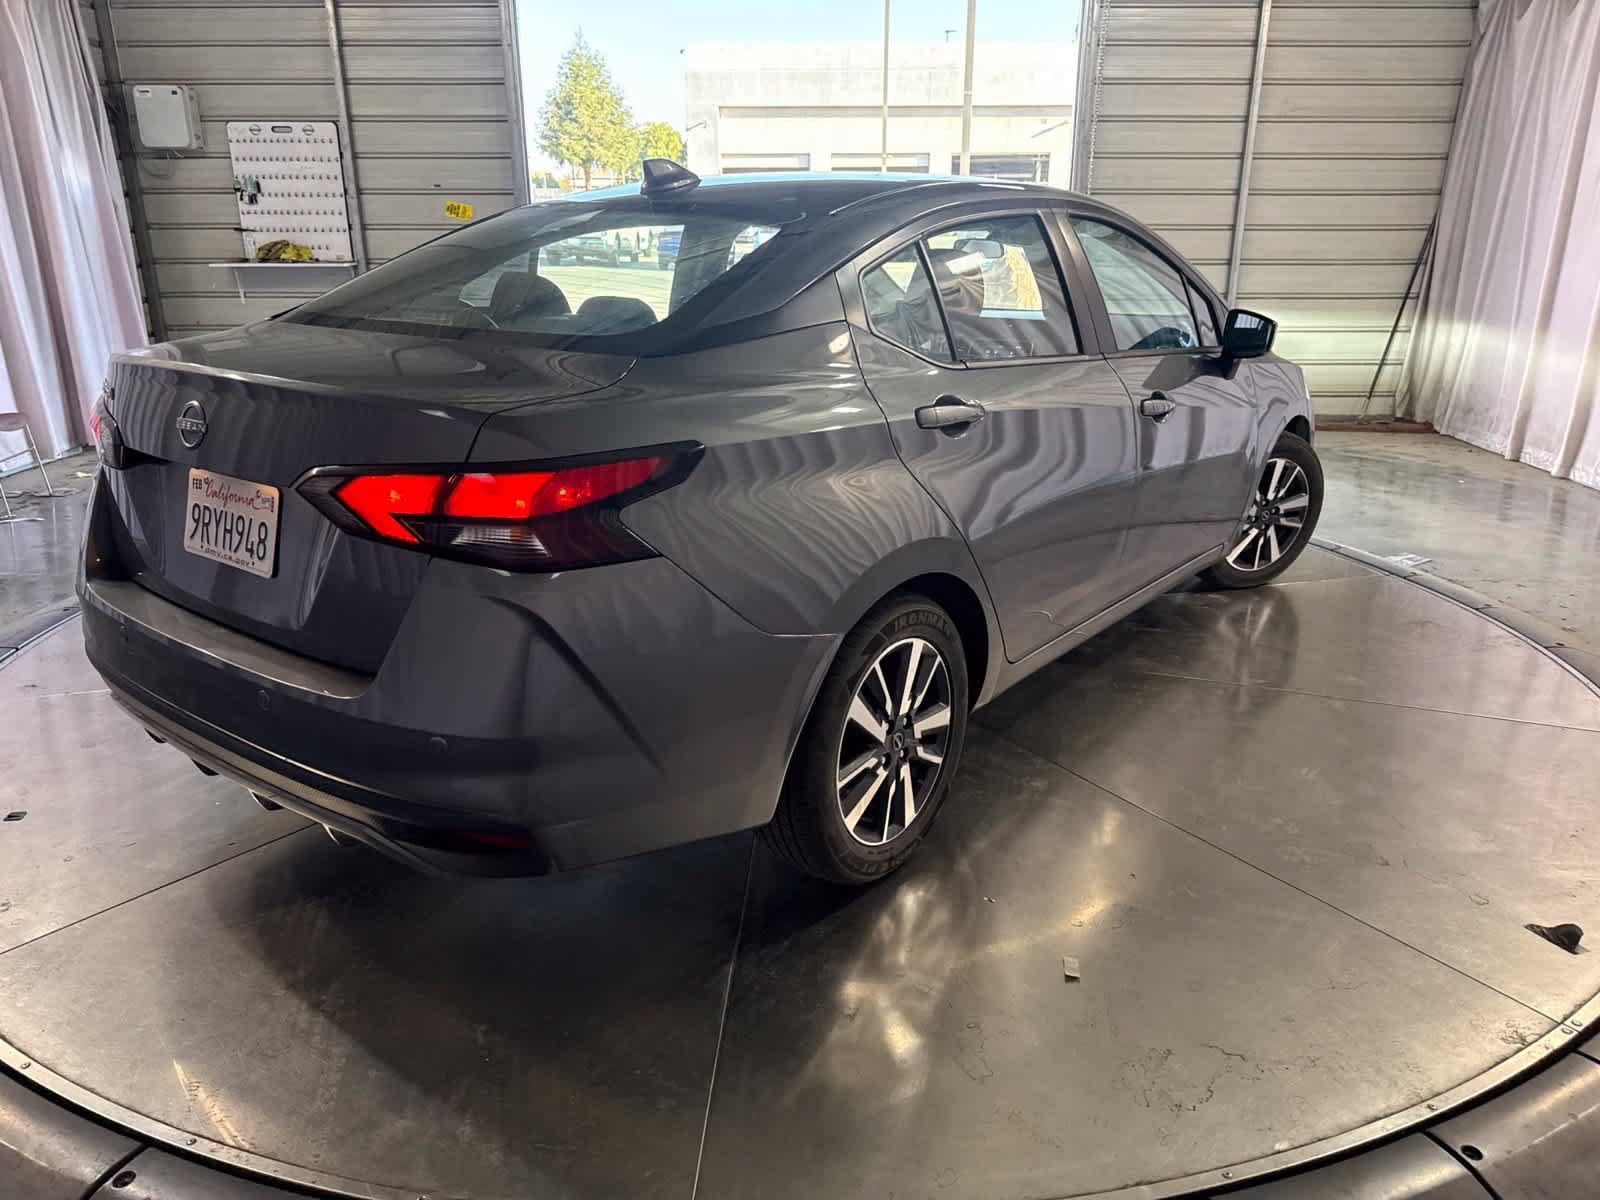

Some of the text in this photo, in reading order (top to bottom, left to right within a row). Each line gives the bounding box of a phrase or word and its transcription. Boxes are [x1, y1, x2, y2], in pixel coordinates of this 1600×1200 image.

[192, 478, 202, 490] FEB
[205, 478, 256, 507] California
[190, 503, 268, 561] 9RYH948
